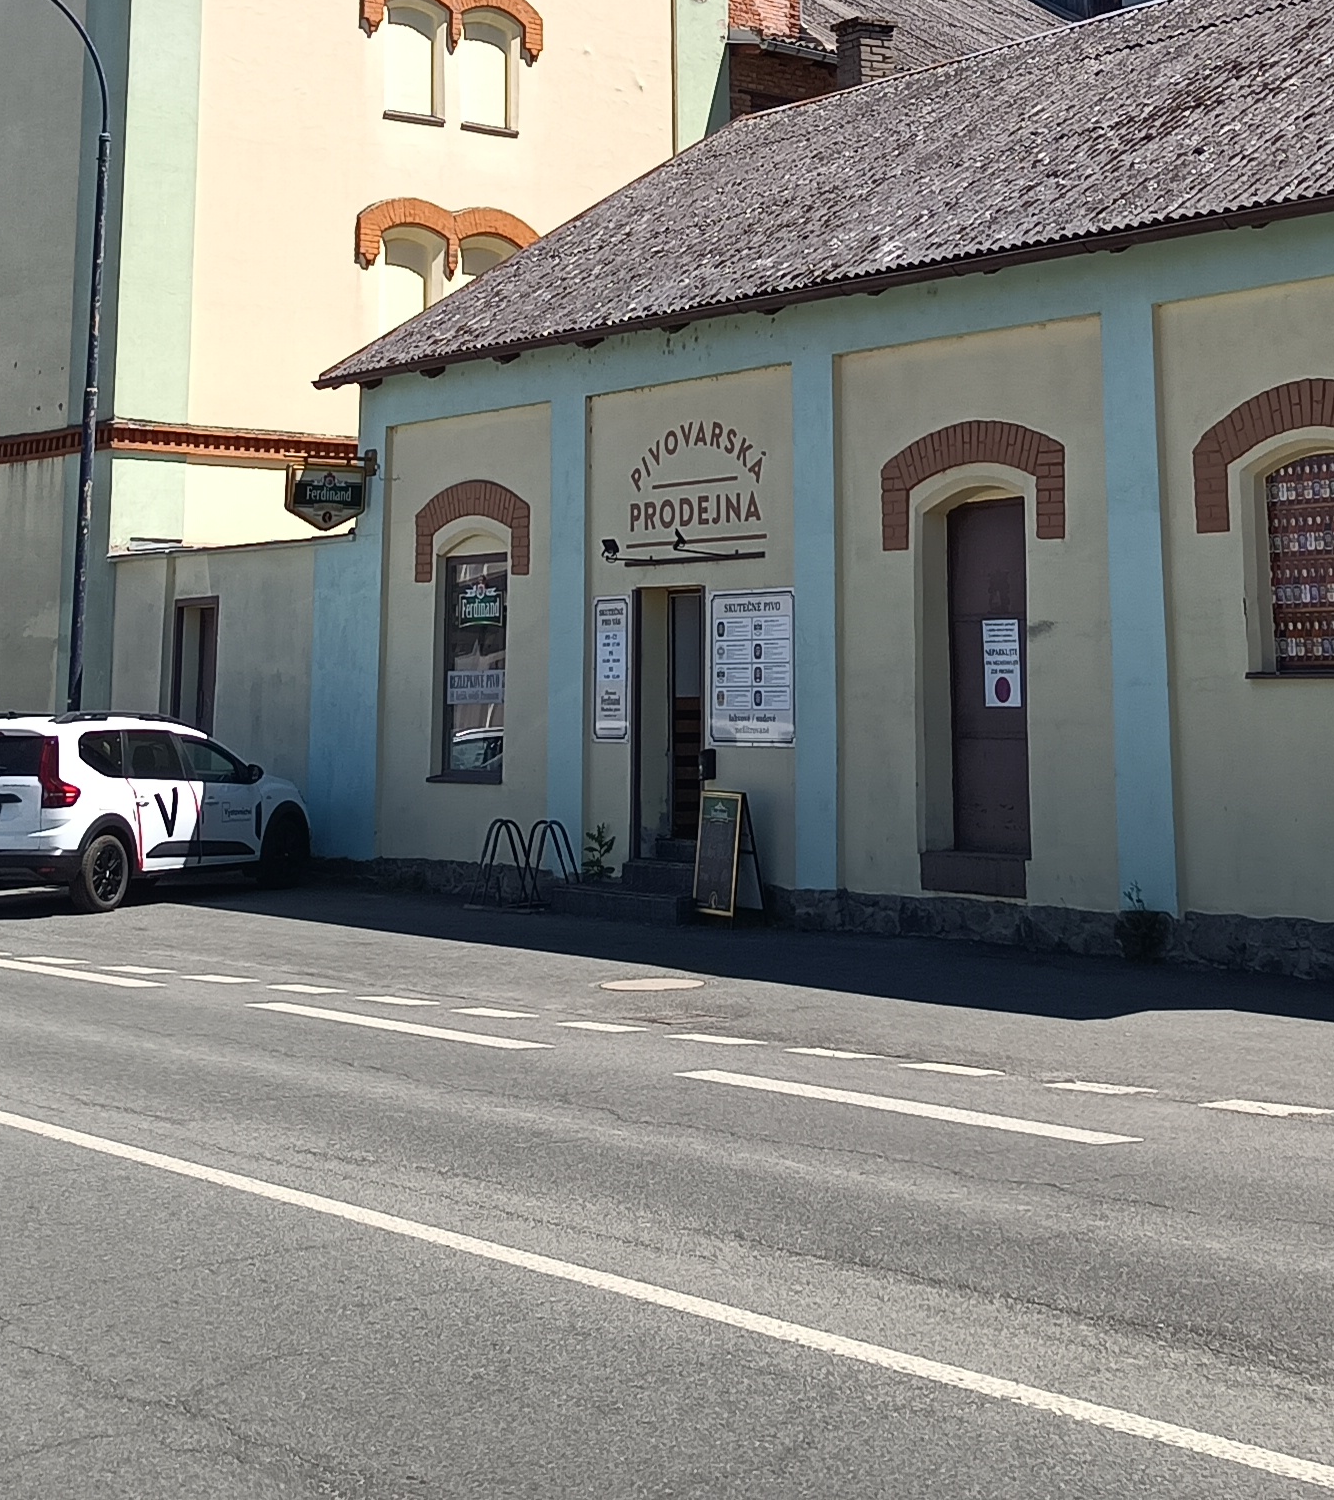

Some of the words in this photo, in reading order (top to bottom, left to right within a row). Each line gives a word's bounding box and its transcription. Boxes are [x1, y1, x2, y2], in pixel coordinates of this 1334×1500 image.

[629, 420, 767, 492] PIVOVARSKÁ
[306, 485, 352, 502] Ferdinand
[630, 492, 762, 531] PRODEJNA
[461, 597, 500, 619] Ferdinand
[724, 600, 762, 613] SKUTEČNÉ
[763, 601, 781, 612] PIVO
